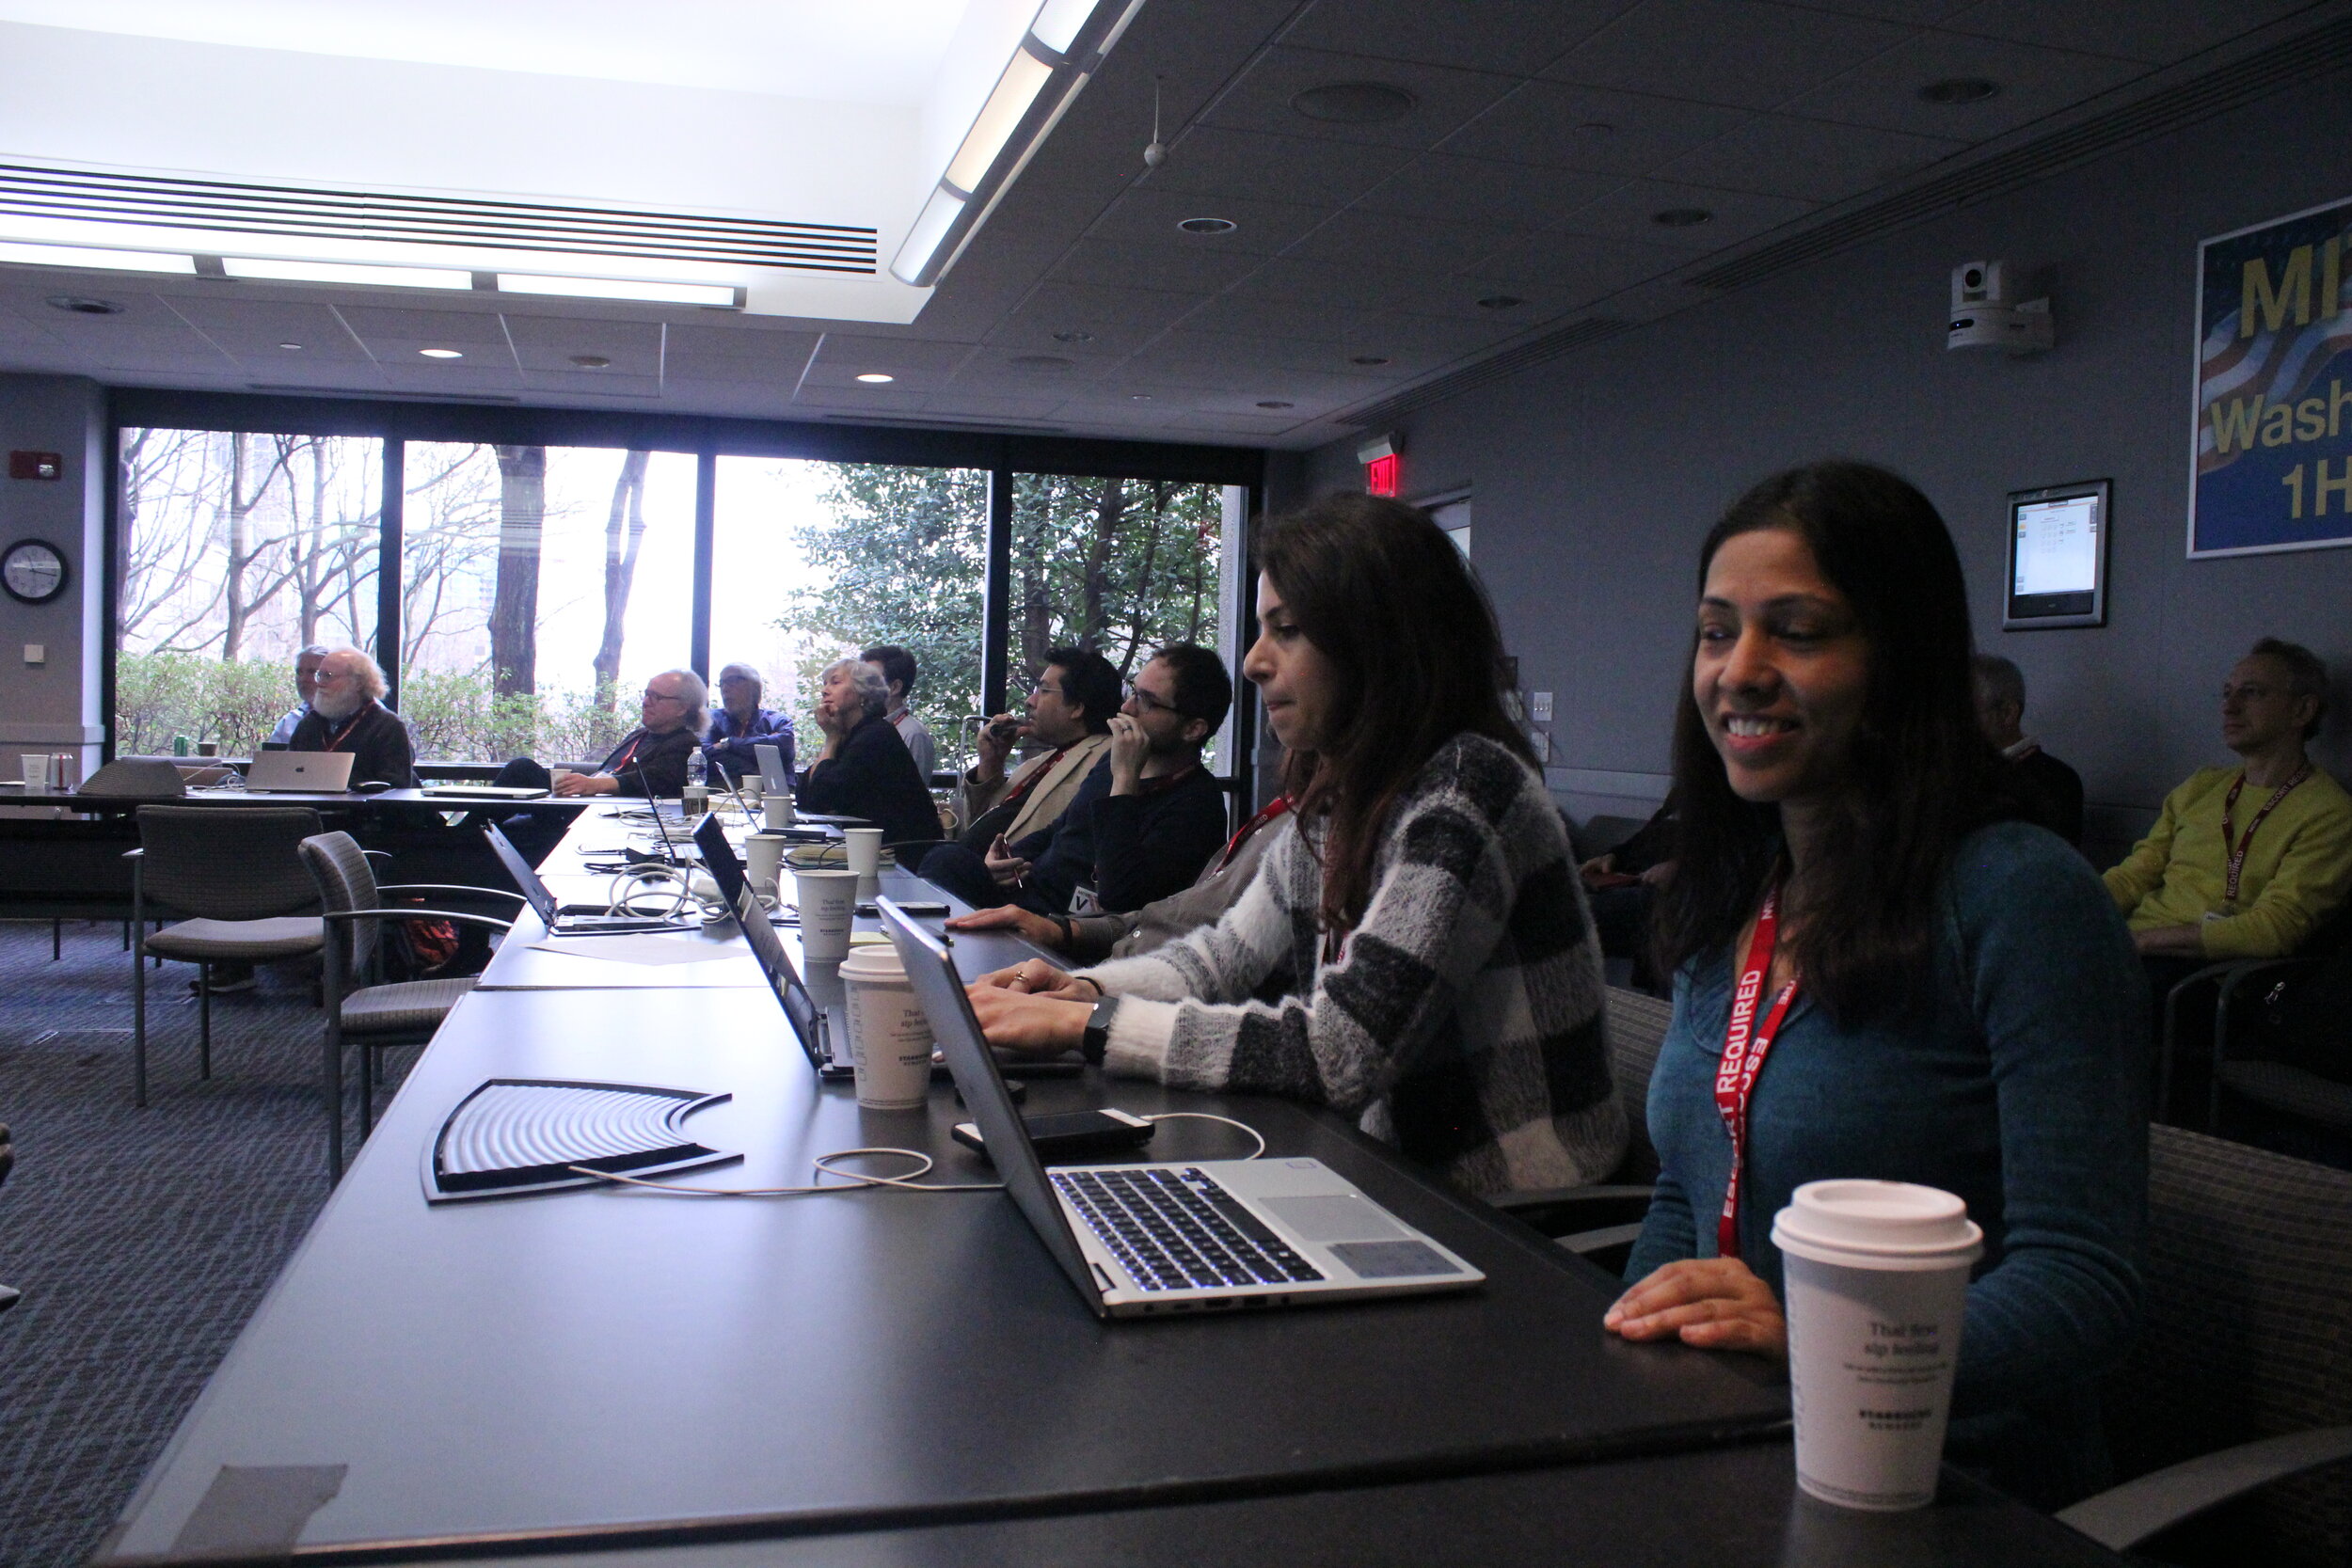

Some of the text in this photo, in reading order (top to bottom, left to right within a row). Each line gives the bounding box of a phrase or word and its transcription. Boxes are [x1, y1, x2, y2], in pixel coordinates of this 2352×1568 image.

[2241, 232, 2352, 340] MI
[2227, 850, 2244, 896] REQUIRED
[1716, 970, 1761, 1093] REQUIRED
